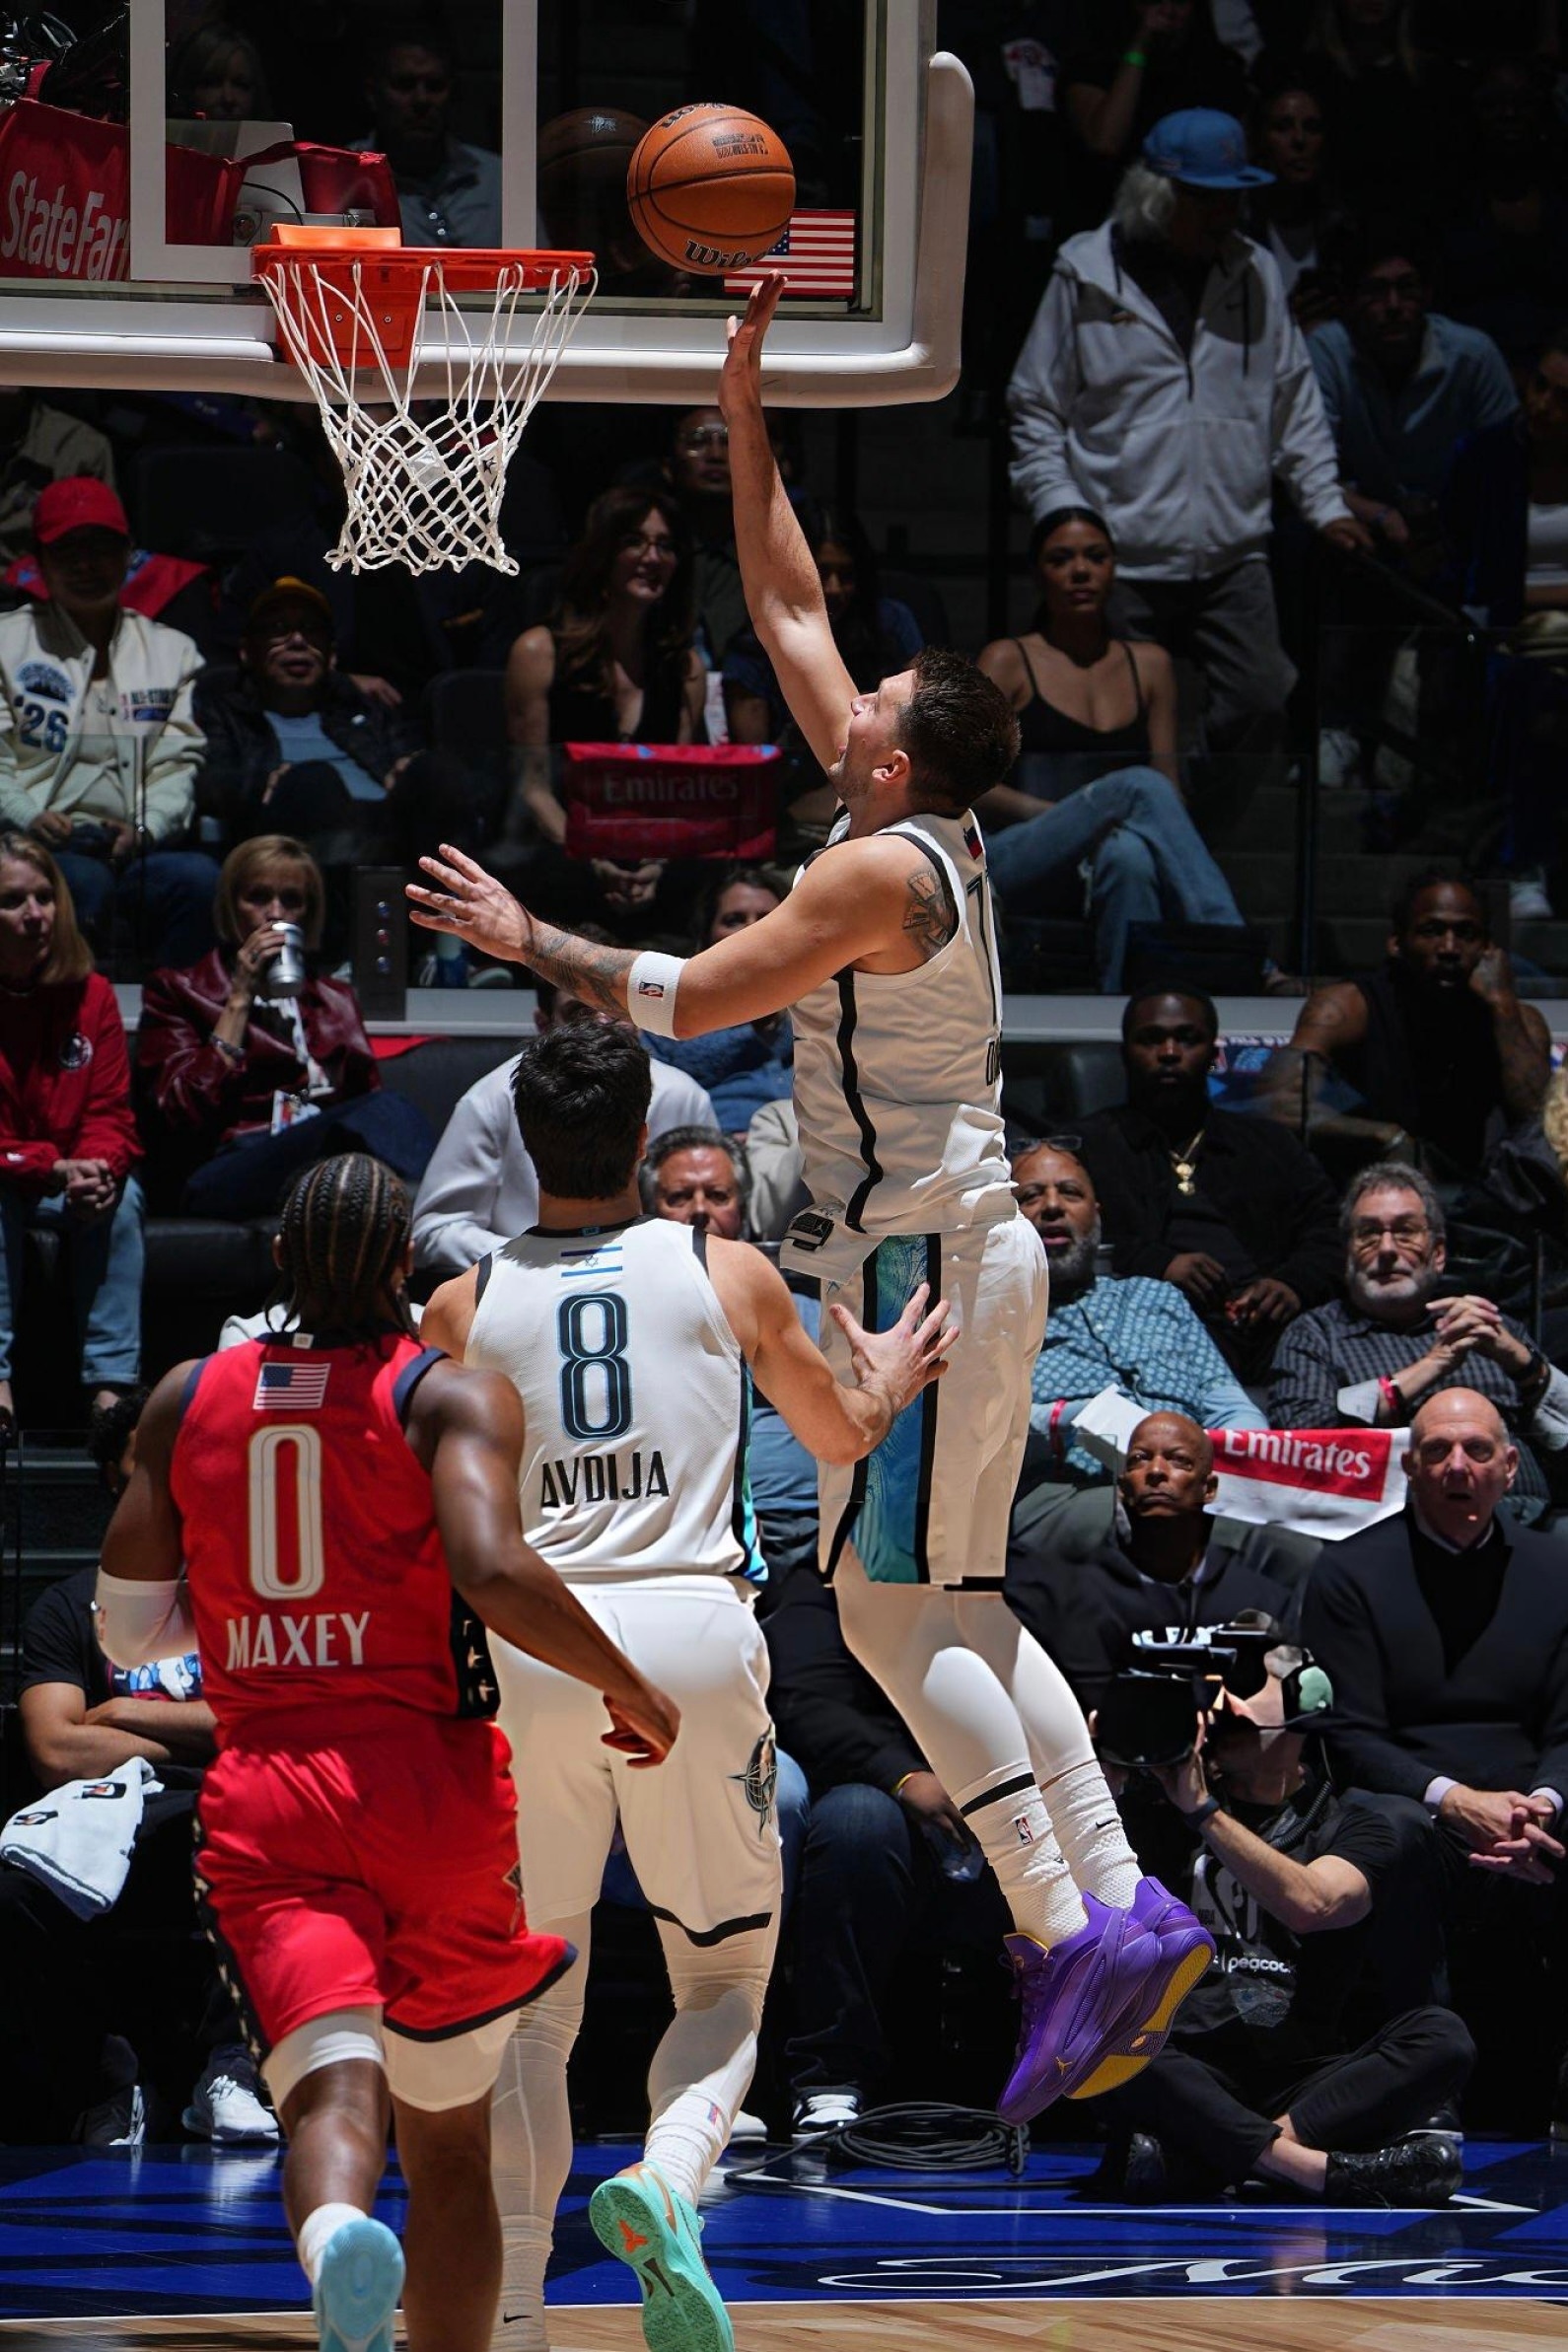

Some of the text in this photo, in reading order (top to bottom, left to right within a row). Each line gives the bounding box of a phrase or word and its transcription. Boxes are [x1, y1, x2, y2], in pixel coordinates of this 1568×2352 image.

[604, 769, 739, 805] Emirates
[556, 1292, 633, 1441] 8
[541, 1451, 670, 1508] AVDIJA
[1225, 1430, 1371, 1479] Emirates
[249, 1423, 325, 1600] 0
[225, 1611, 370, 1671] MAXEY
[1228, 1957, 1295, 1973] peacoc
